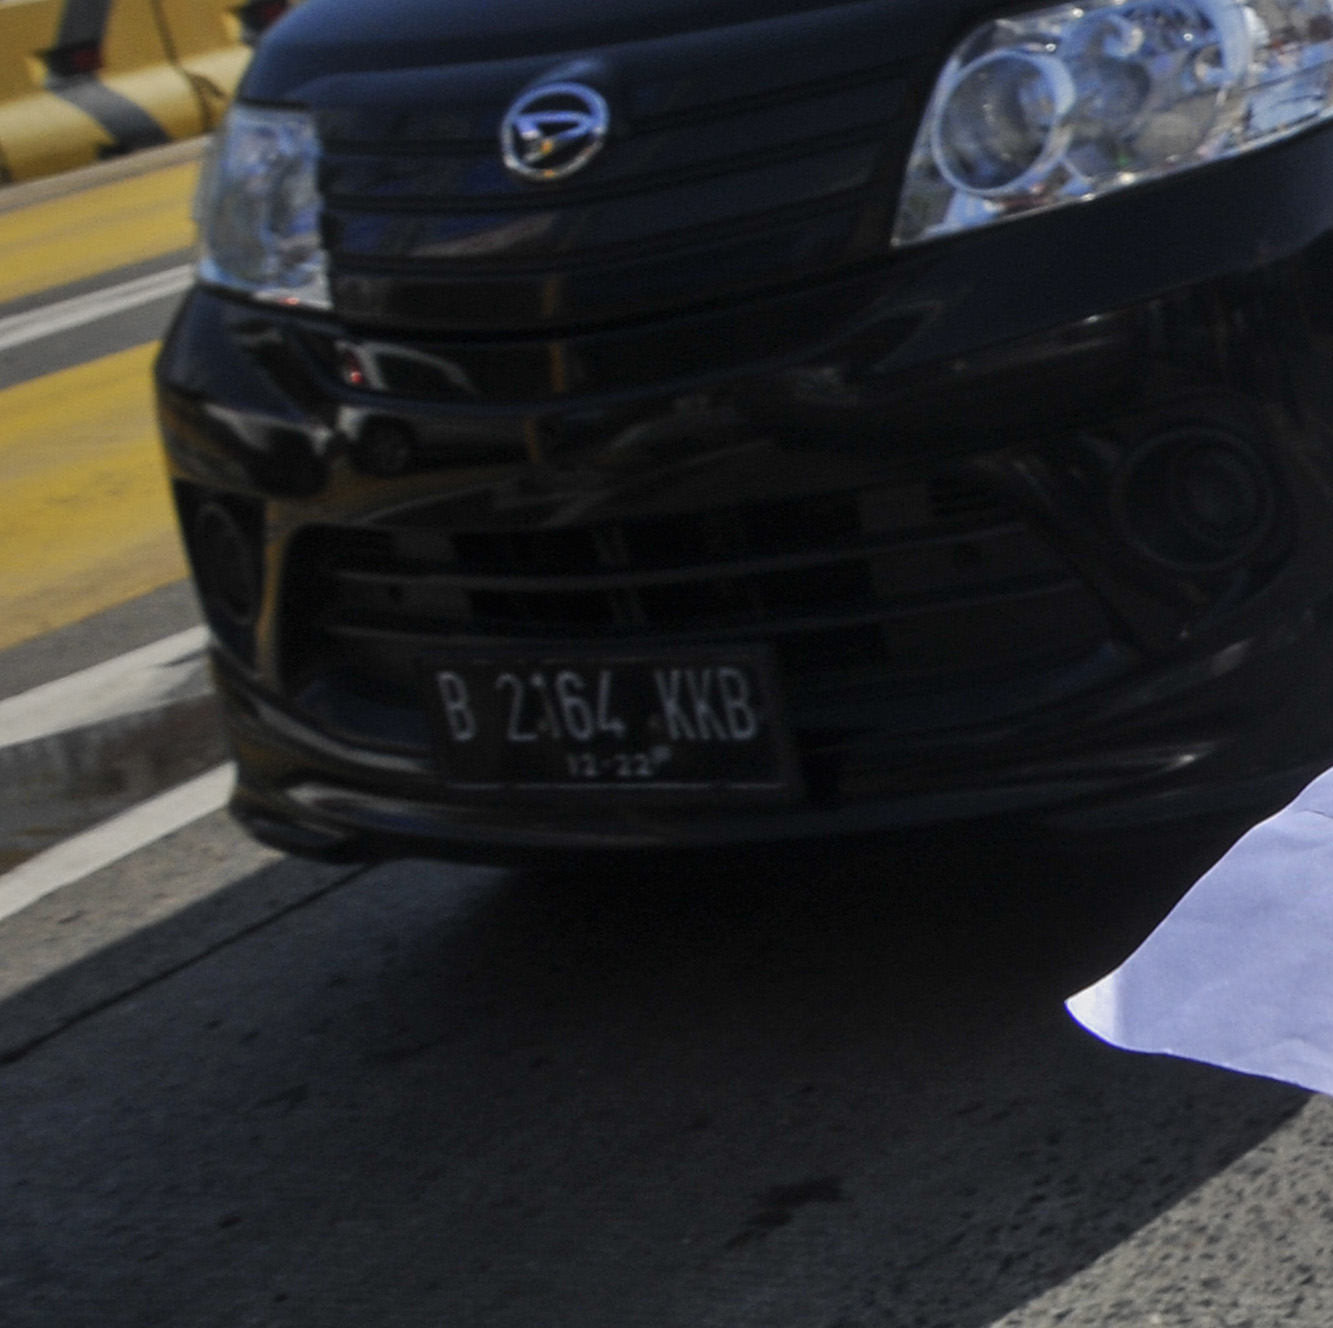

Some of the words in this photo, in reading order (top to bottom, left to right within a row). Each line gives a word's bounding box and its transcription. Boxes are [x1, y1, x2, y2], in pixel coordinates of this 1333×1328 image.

[437, 671, 477, 742] B
[496, 670, 626, 742] 2164
[654, 666, 758, 741] KKB
